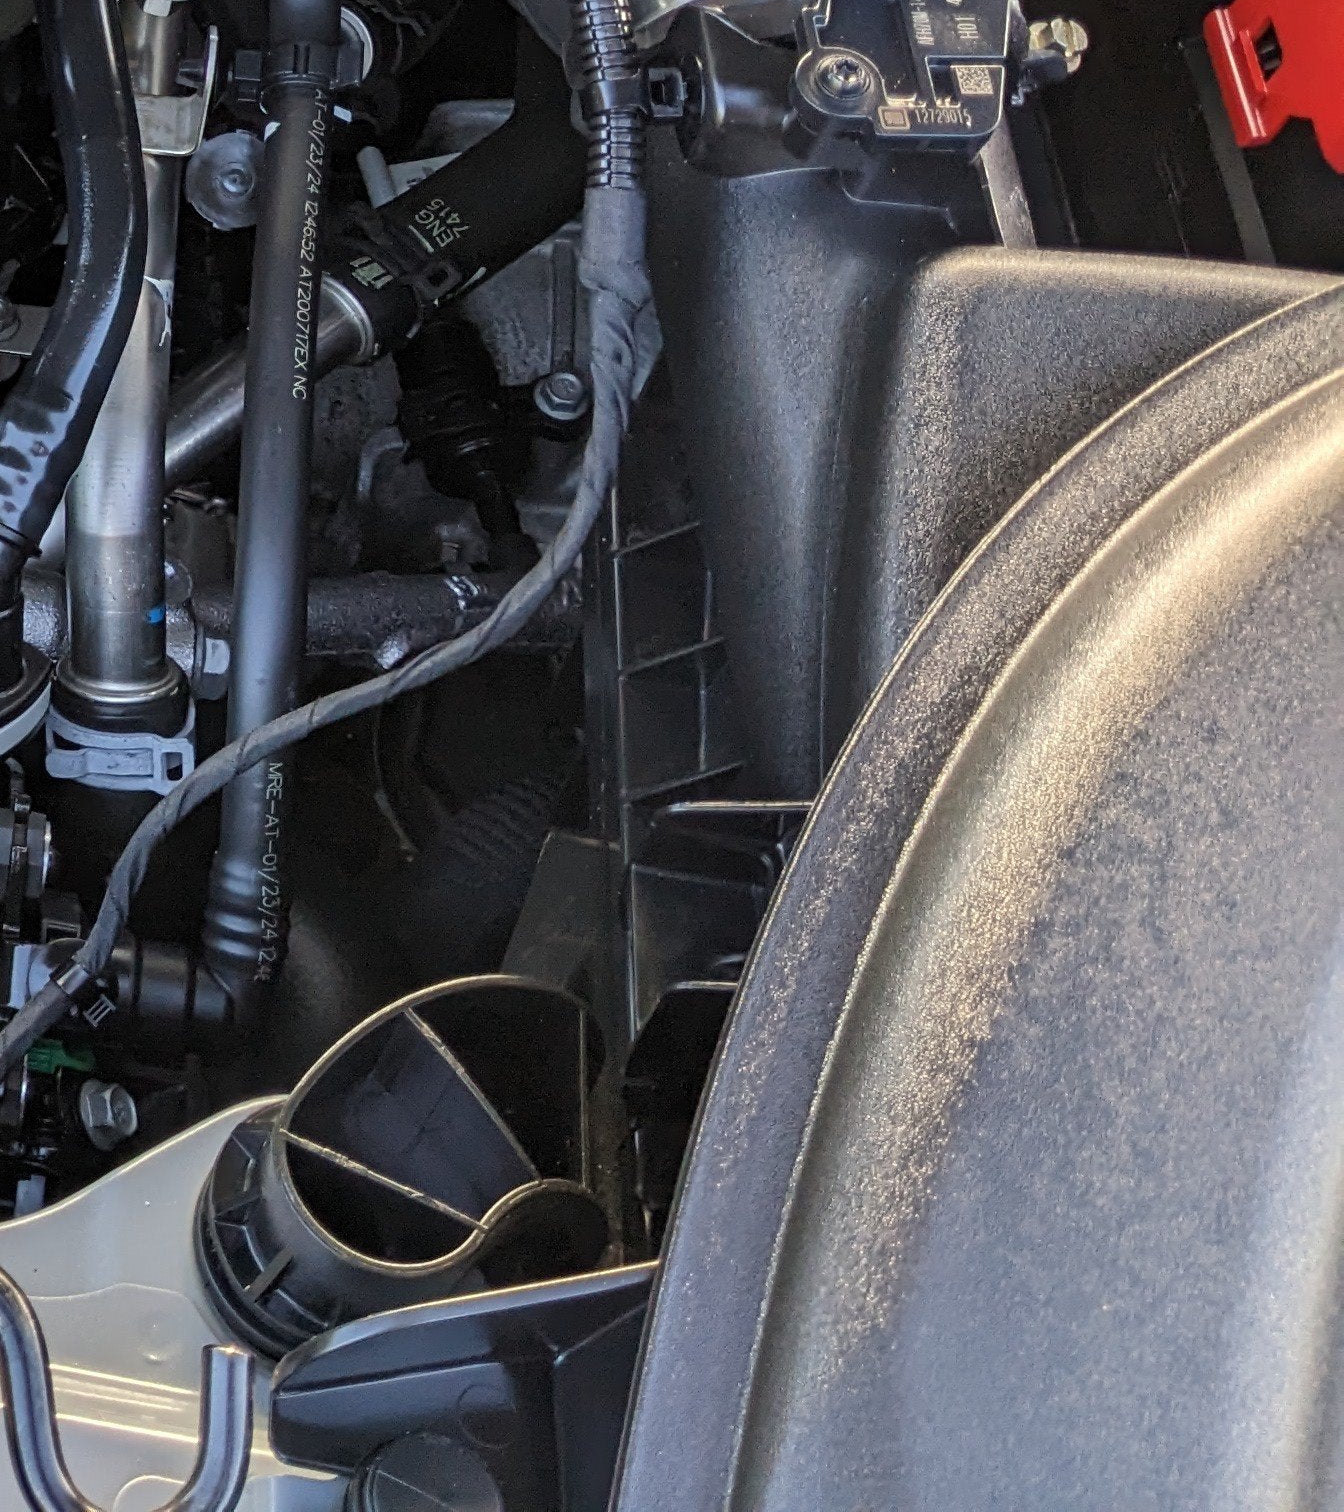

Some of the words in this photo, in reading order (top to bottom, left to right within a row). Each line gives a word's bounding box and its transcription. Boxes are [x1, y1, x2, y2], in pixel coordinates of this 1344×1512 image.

[415, 209, 454, 247] ENG
[427, 199, 469, 238] 7415
[294, 265, 312, 371] AT200717EX
[292, 375, 308, 400] NC
